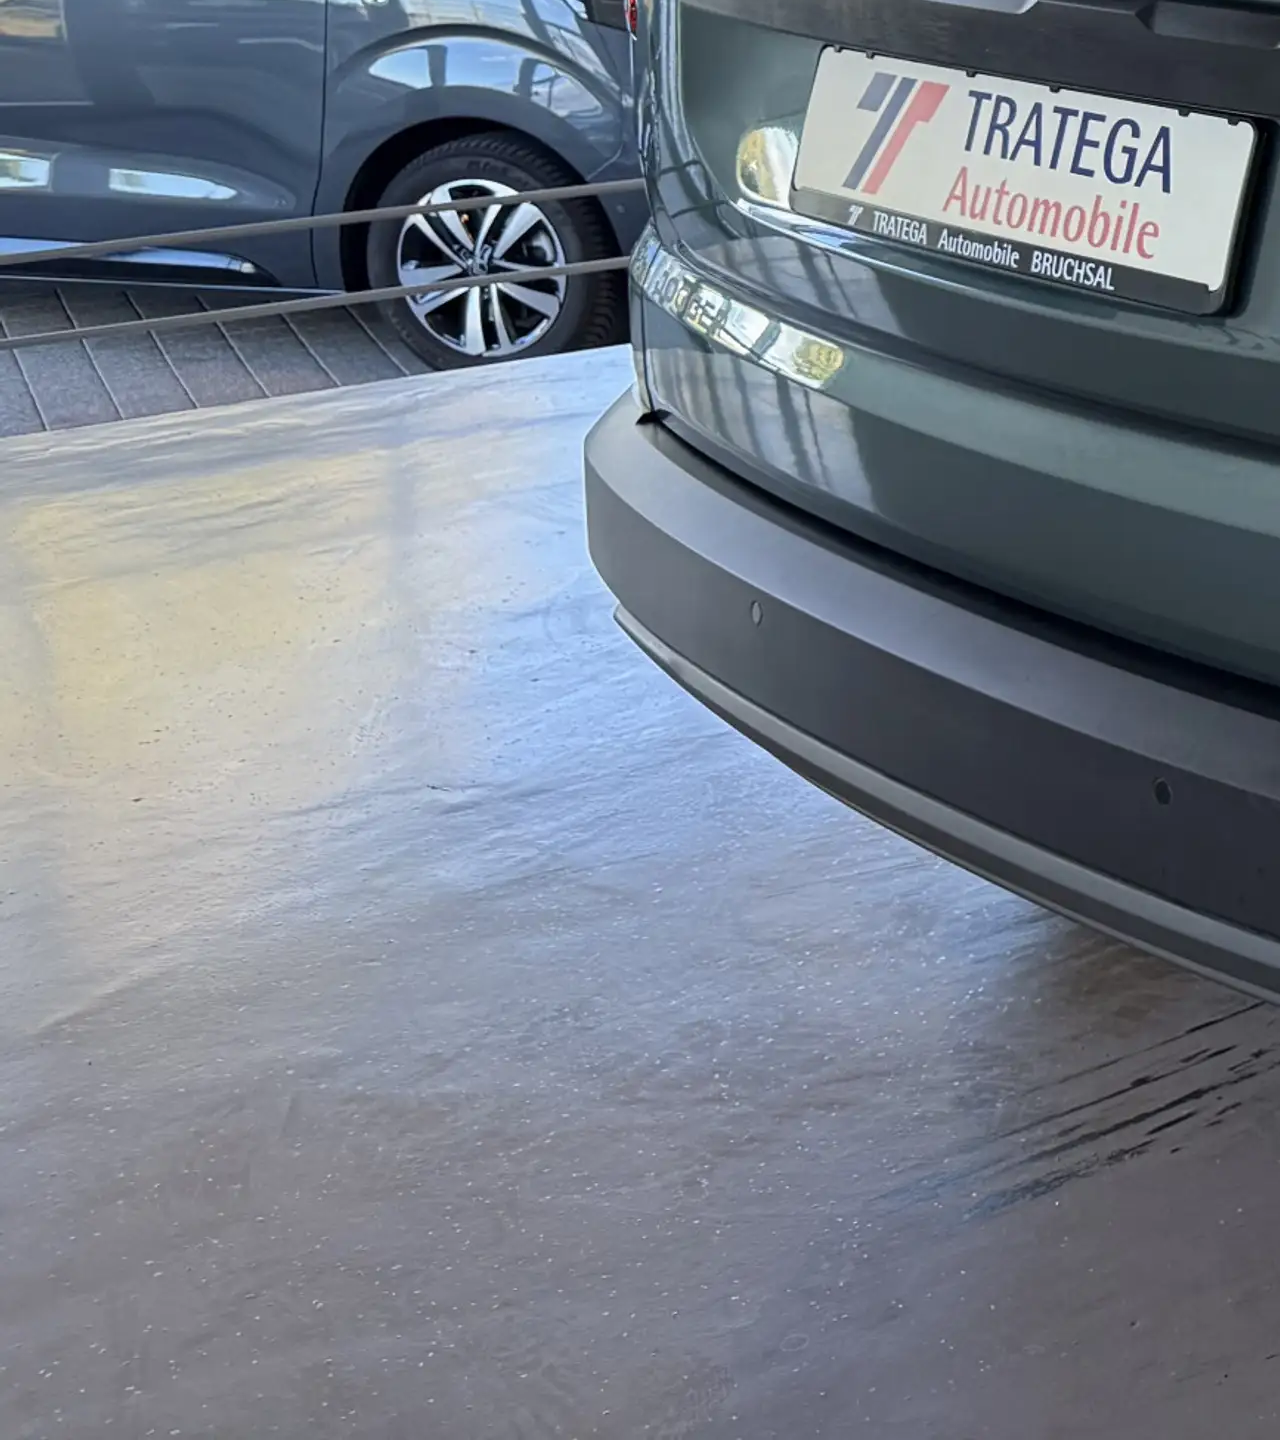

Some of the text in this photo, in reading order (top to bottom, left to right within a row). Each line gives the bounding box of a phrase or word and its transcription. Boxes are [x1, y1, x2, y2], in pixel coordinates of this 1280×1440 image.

[965, 91, 1171, 194] TRATEGA
[873, 211, 1115, 291] TRATEGA Automobile BRUCHSAL
[944, 167, 1160, 260] Automobile
